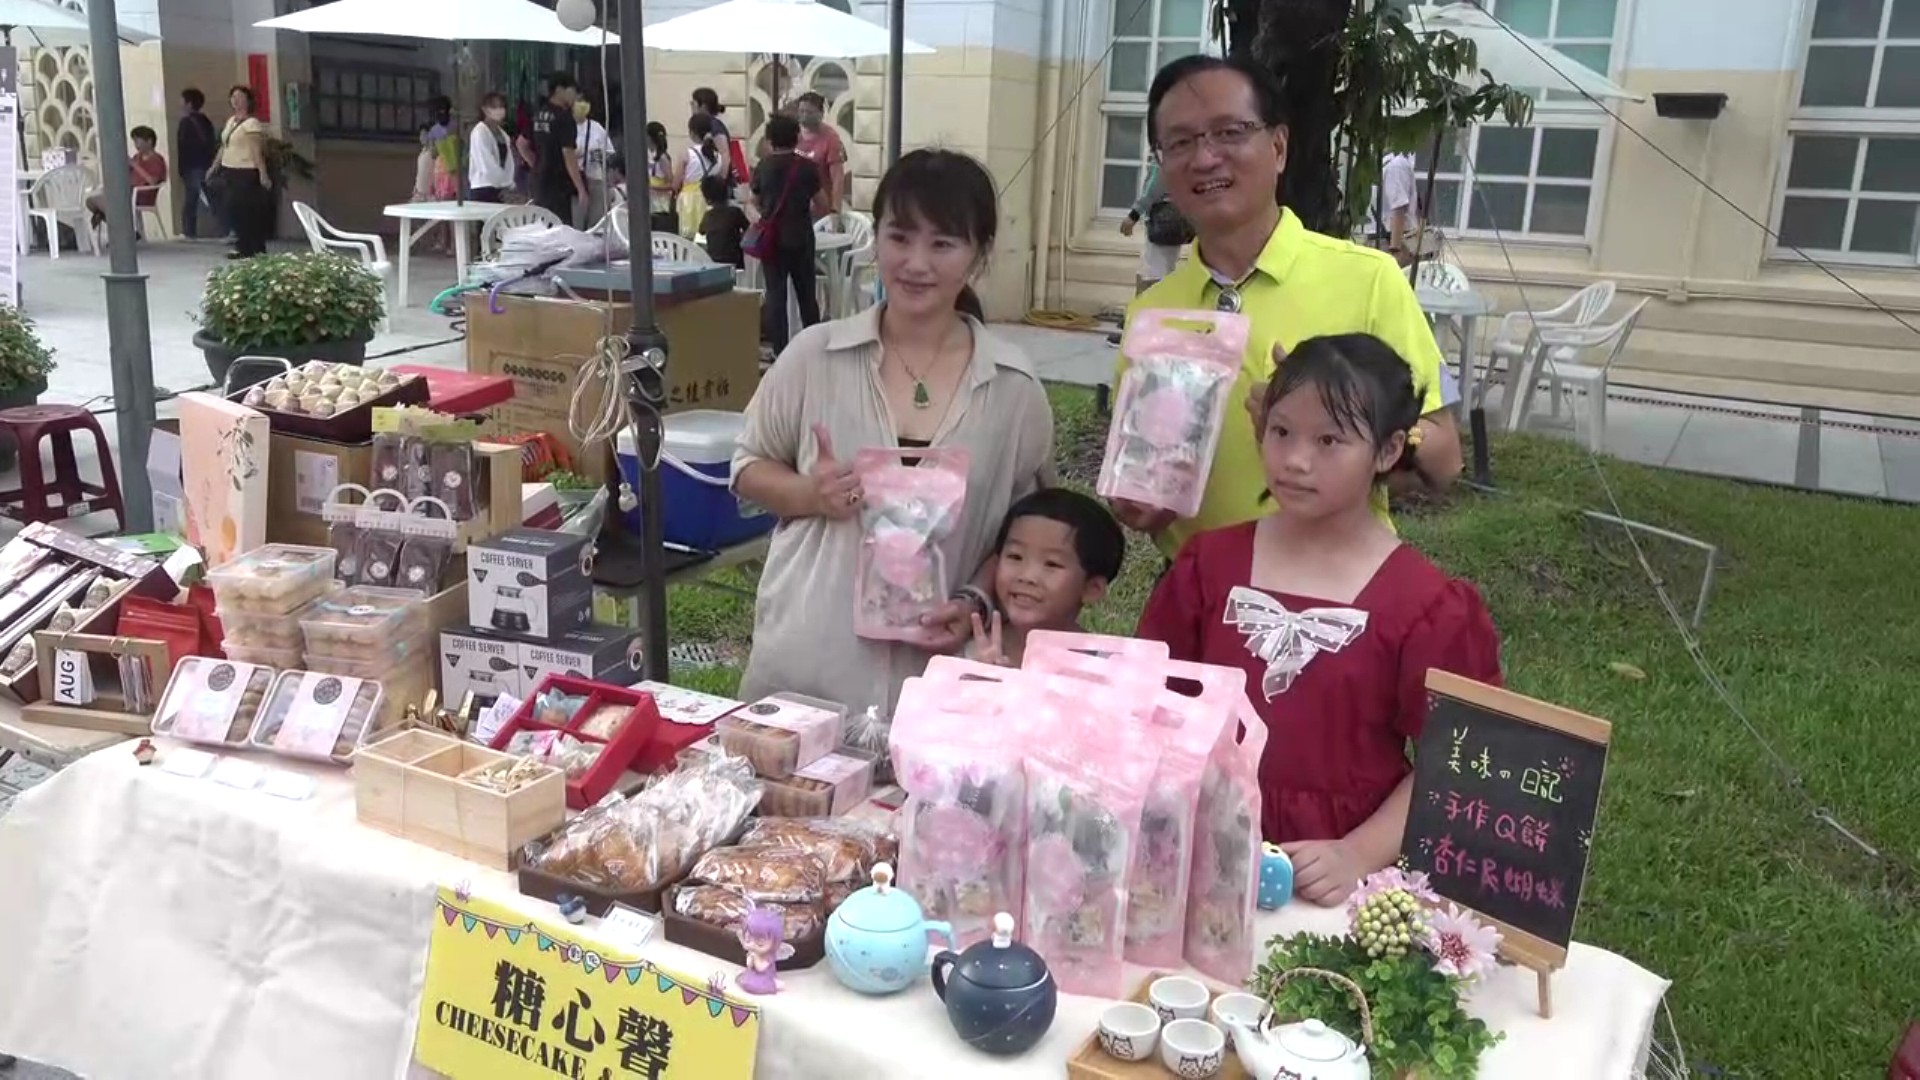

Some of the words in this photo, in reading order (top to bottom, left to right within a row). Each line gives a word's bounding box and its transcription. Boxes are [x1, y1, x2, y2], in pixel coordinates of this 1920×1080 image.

[481, 552, 505, 566] COFFEE
[506, 555, 533, 569] SERVER
[452, 638, 476, 652] COFFEE
[477, 641, 505, 655] SERVER
[530, 650, 554, 664] COFFEE
[555, 653, 581, 667] SERVER
[63, 659, 76, 700] AUG
[435, 1000, 588, 1080] CHEESECAKE
